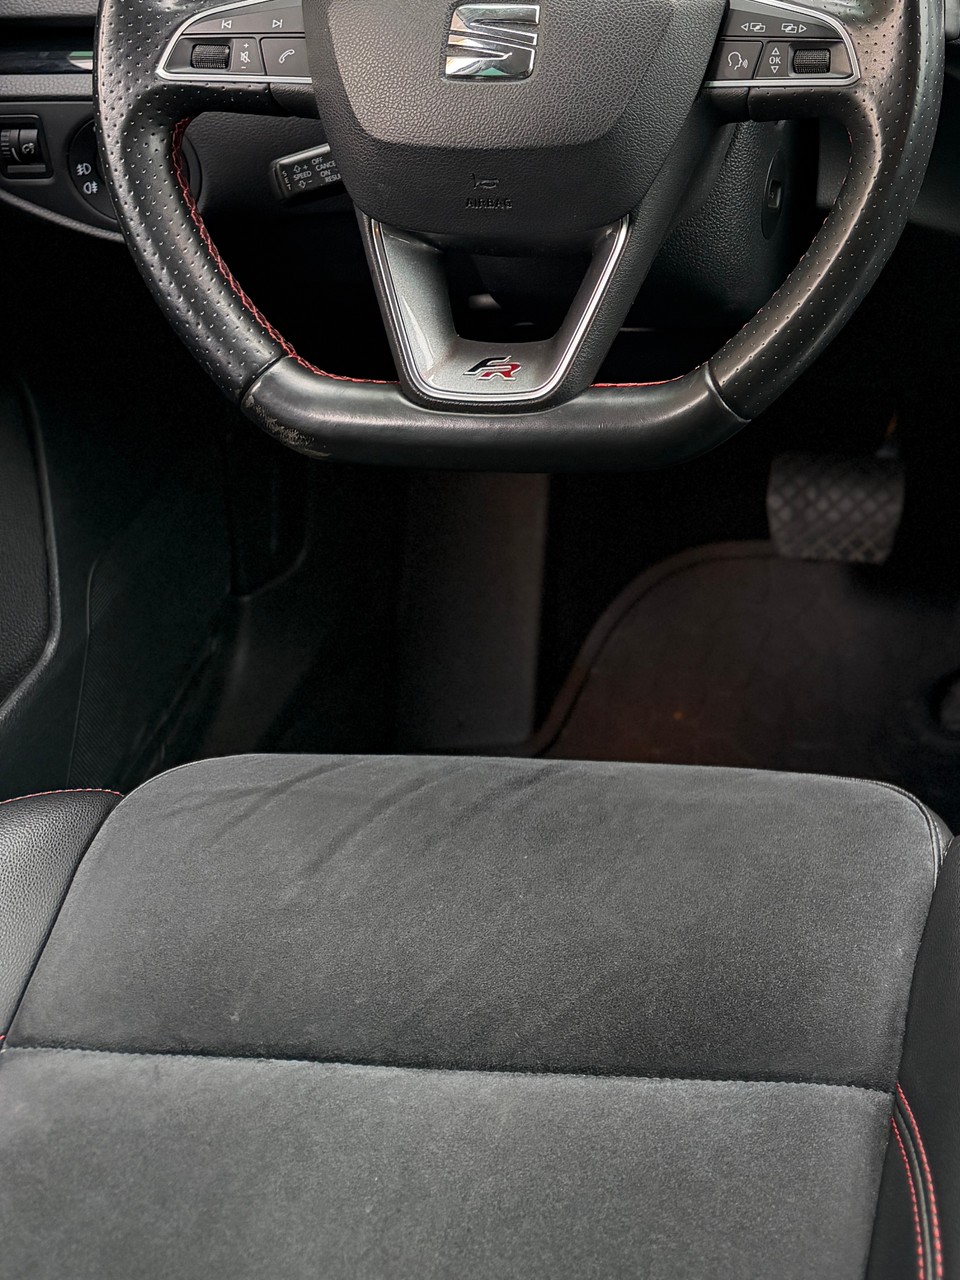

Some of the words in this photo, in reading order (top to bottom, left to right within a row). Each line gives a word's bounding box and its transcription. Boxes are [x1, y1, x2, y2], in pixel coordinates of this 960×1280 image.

[769, 56, 781, 65] OK
[311, 156, 323, 166] OFF
[315, 160, 336, 171] CANCE
[293, 170, 312, 182] SPEED
[320, 170, 331, 178] ON
[465, 198, 513, 210] AIRBAG
[463, 356, 522, 381] FR
